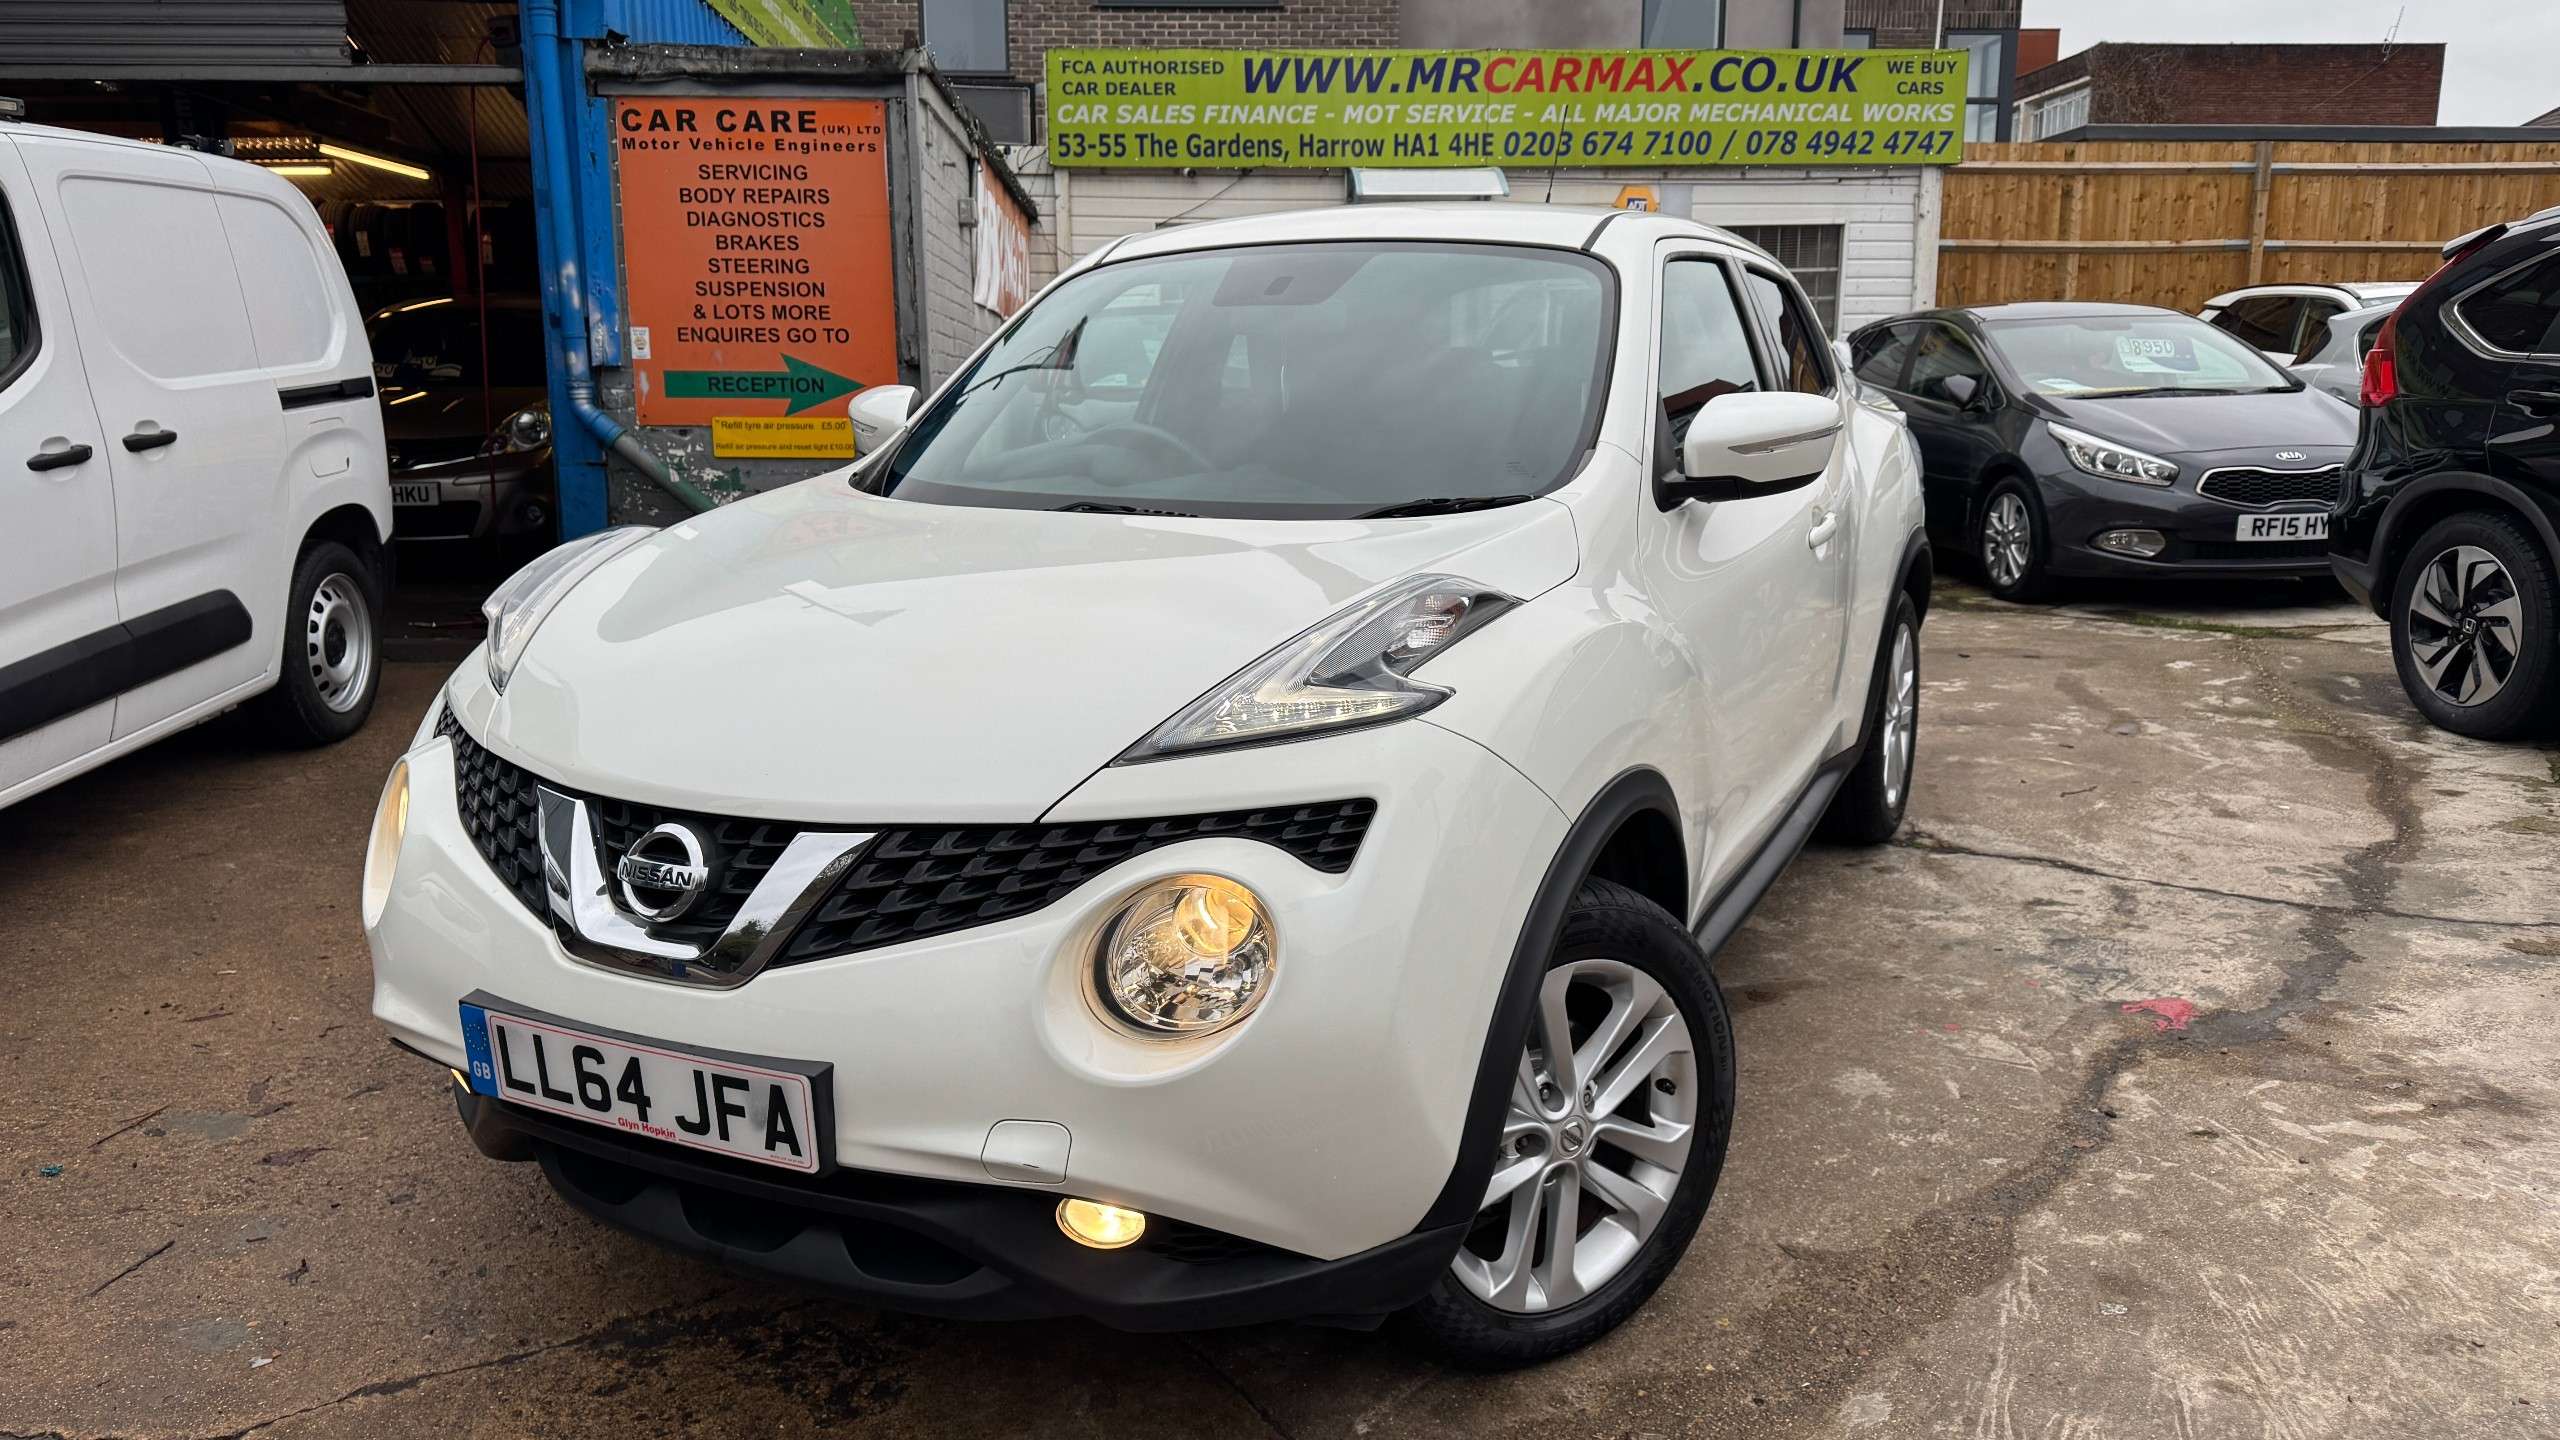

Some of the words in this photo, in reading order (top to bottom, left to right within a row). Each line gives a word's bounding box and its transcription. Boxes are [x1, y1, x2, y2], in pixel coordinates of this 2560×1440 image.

[1062, 61, 1096, 74] FCA
[1102, 60, 1225, 75] AUTHORISED
[1243, 56, 1865, 93] WWW.MRCARMAX.CO.UK
[1887, 61, 1914, 74] WE
[1921, 61, 1957, 74] BUY
[1062, 82, 1099, 96] CAR
[1106, 82, 1177, 96] DEALER
[1896, 81, 1944, 95] CARS
[621, 109, 698, 133] CAR
[715, 110, 817, 134] CARE
[821, 124, 851, 136] (UK)
[857, 126, 882, 136] LTD
[1057, 104, 1110, 125] CAR
[1116, 104, 1197, 125] SALES
[1203, 104, 1318, 124] FINANCE
[1343, 104, 1400, 124] MOT
[1405, 104, 1517, 124] SERVICE
[1540, 104, 1585, 124] ALL
[1594, 104, 1680, 123] MAJOR
[1688, 103, 1853, 123] MECHANICAL
[1862, 103, 1955, 122] WORKS
[622, 138, 680, 151] Motor
[688, 138, 766, 152] Vehicle
[775, 139, 878, 155] Engineers
[1058, 134, 1127, 158] 53-55
[1135, 134, 1178, 158] The
[1186, 134, 1291, 163] Gardens,
[1299, 133, 1385, 157] Harrow
[1393, 133, 1439, 156] HA1
[1448, 133, 1494, 156] 4HE
[1504, 131, 1572, 156] 0203
[1583, 131, 1634, 156] 674
[1643, 131, 1712, 155] 7100
[1719, 130, 1738, 160] /
[1746, 131, 1798, 155] 078
[1806, 131, 1873, 155] 4942
[1882, 131, 1954, 155] 4747
[698, 164, 808, 181] SERVICING
[679, 188, 736, 204] BODY
[743, 189, 830, 205] REPAIRS
[687, 212, 826, 228] DIAGNOSTICS
[716, 235, 800, 251] BRAKES
[708, 258, 810, 275] STEERING
[695, 281, 826, 298] SUSPENSION
[693, 305, 707, 321] &
[713, 304, 766, 321] LOTS
[772, 304, 831, 321] MORE
[678, 327, 780, 345] ENQUIRES
[786, 327, 817, 344] GO
[823, 327, 850, 344] TO
[707, 376, 825, 393] RECEPTION
[721, 421, 743, 430] Refill
[744, 421, 761, 431] tyre
[764, 422, 774, 430] air
[2278, 451, 2305, 460] KIA
[392, 485, 430, 503] HKU
[2251, 517, 2300, 537] RF15
[621, 860, 692, 888] NISSAN
[473, 1061, 491, 1080] GB
[496, 1024, 652, 1122] LL64
[675, 1069, 803, 1157] JFA
[617, 1116, 640, 1131] Glyn
[641, 1122, 676, 1138] Hopkin
